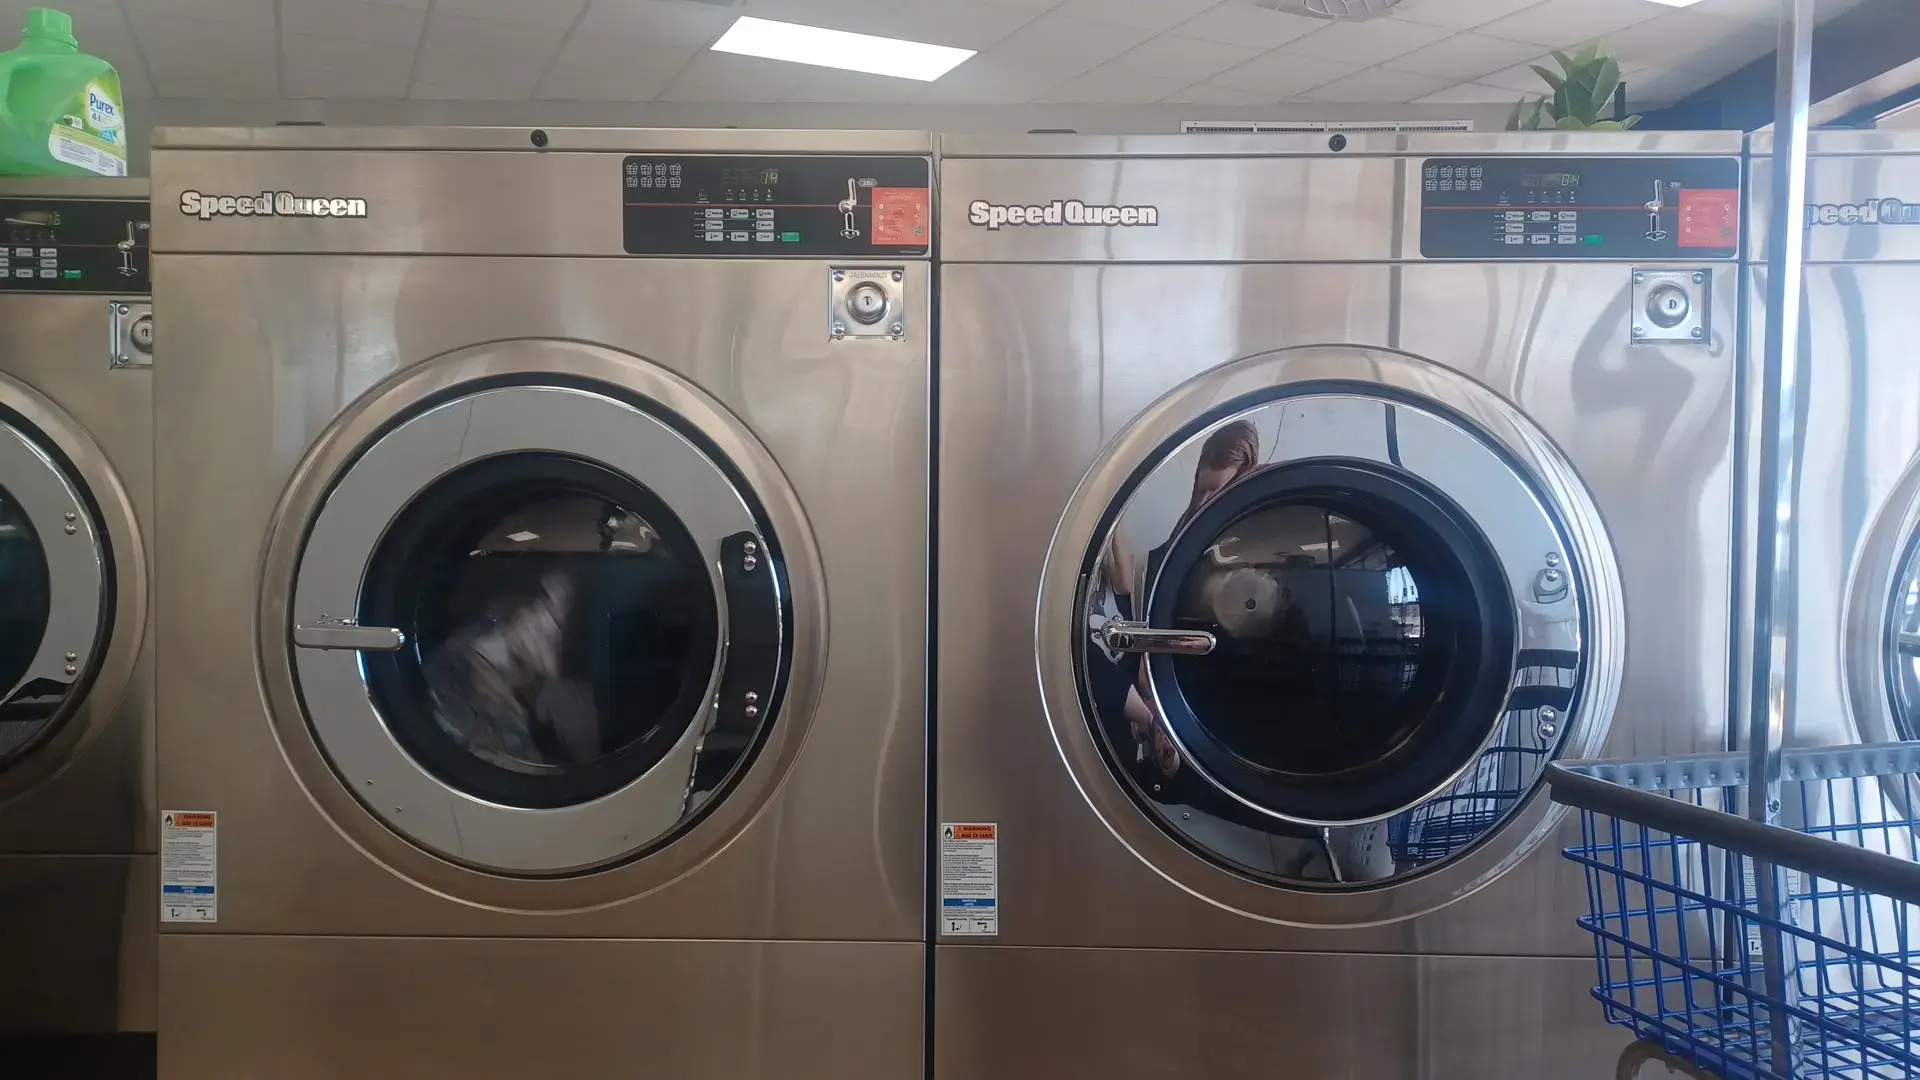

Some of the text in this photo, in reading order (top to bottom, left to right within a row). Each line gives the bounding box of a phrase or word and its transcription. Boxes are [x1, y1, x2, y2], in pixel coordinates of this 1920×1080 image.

[90, 92, 115, 116] Purex
[180, 189, 368, 221] Speed Queen
[968, 199, 1158, 231] Speed Queen
[1803, 198, 1880, 230] peed
